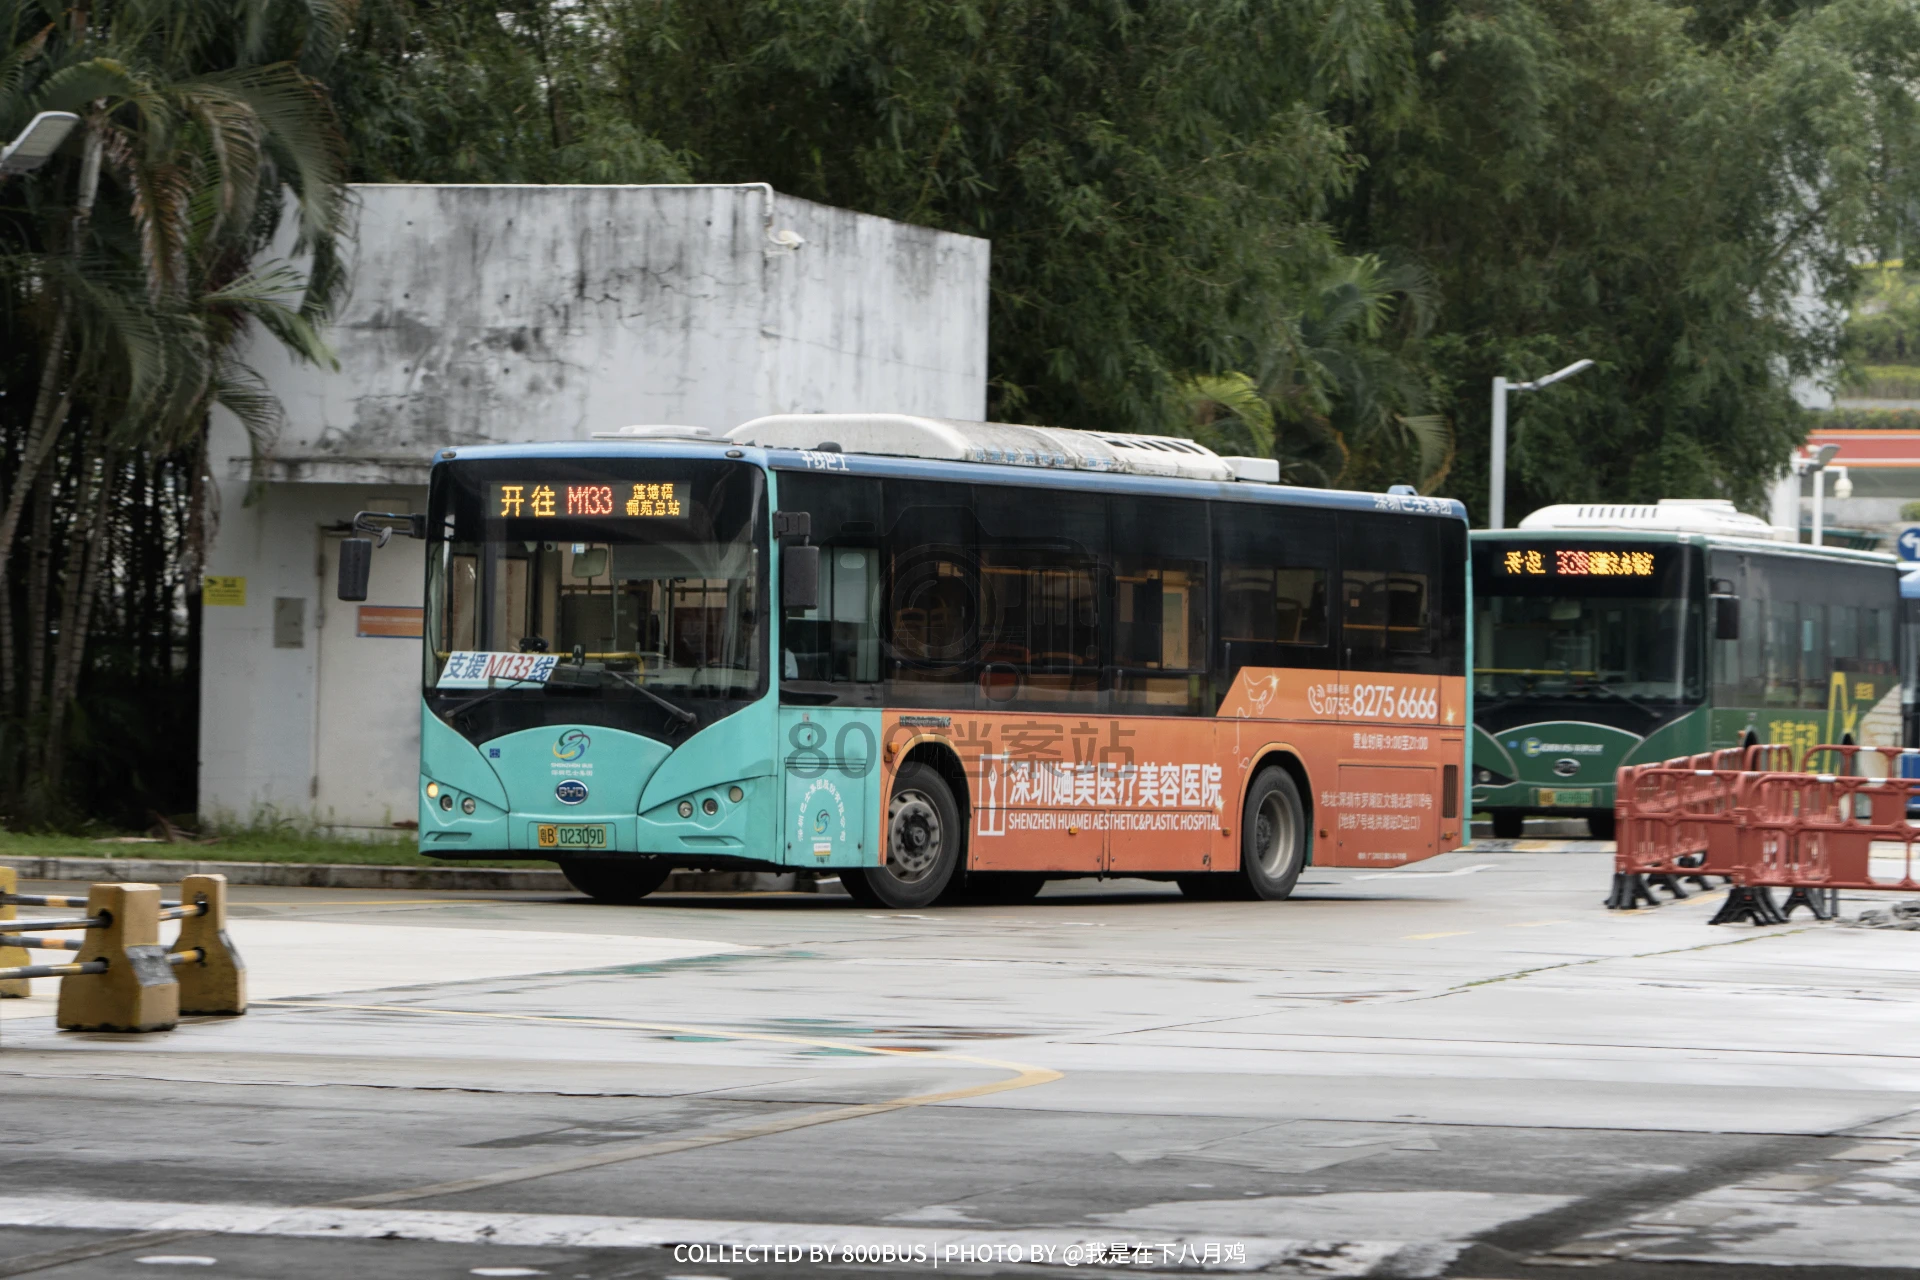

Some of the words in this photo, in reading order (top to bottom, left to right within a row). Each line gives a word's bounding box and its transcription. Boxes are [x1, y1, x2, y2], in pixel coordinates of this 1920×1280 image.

[501, 485, 556, 517] 开往
[567, 486, 613, 515] M133
[626, 500, 681, 516] 桐苑总站
[559, 786, 584, 797] BYD
[1008, 812, 1057, 830] SHENZHEN
[1057, 813, 1093, 830] HUAMEI
[1093, 813, 1180, 831] AESTHETIC&PLASTIC
[1180, 813, 1221, 831] HOSPITAL
